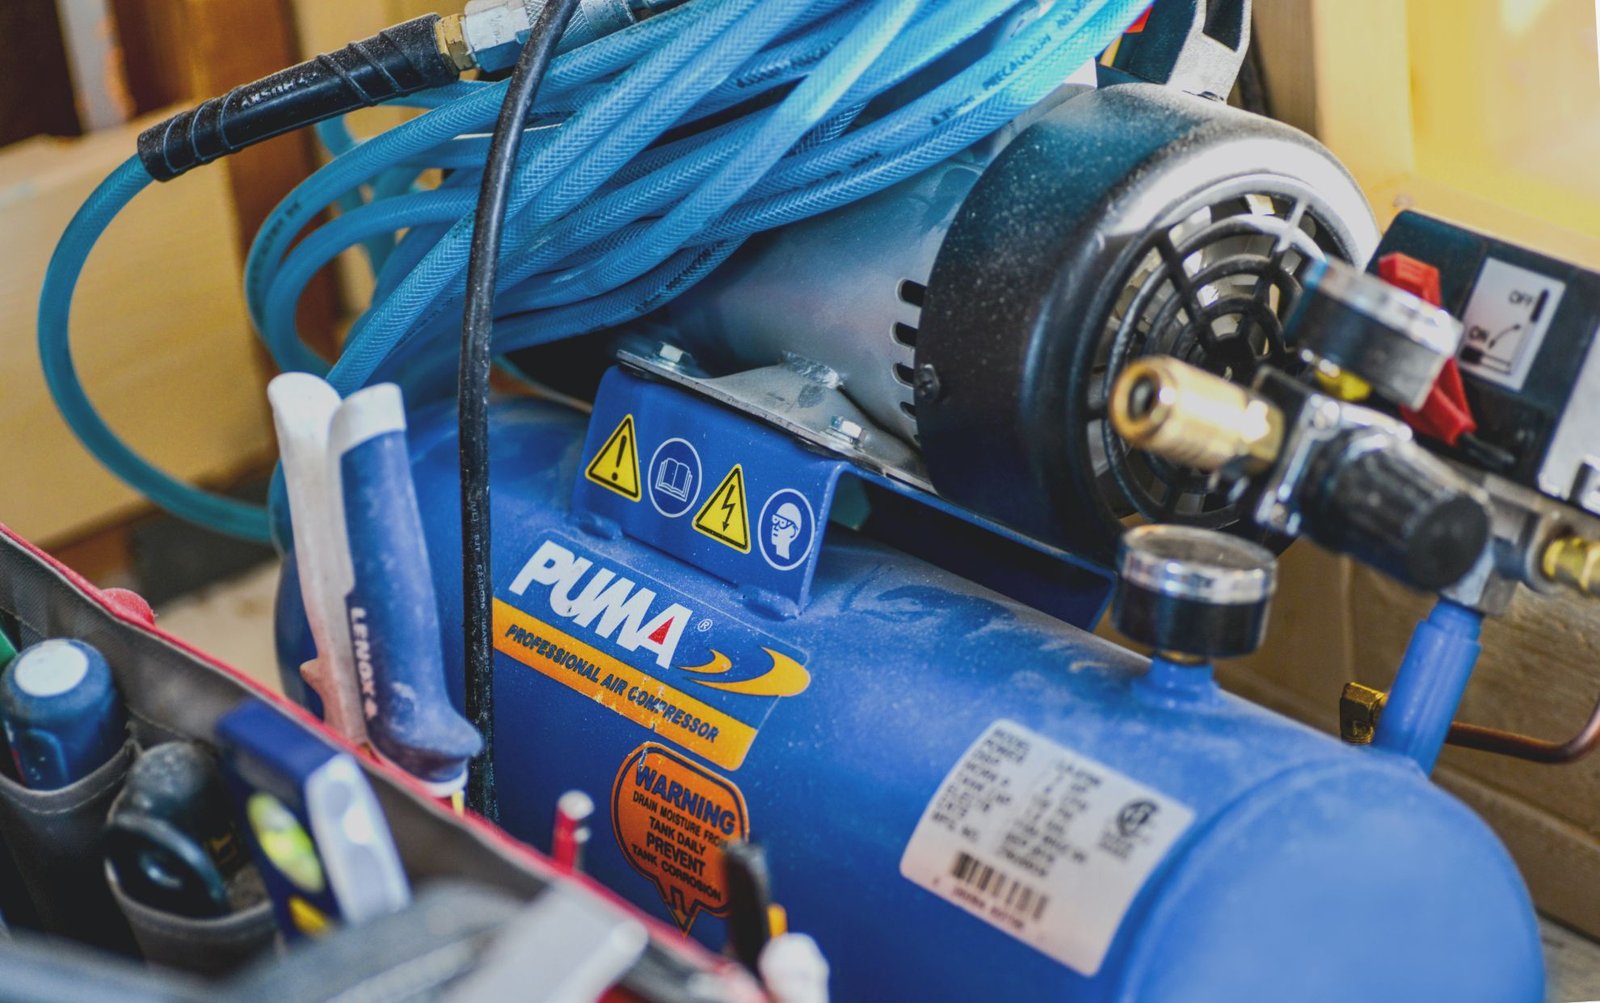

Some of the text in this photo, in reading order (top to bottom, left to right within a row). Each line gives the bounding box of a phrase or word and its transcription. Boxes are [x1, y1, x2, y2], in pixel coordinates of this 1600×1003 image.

[1508, 290, 1534, 306] OFF
[1469, 326, 1488, 342] ON
[508, 539, 693, 670] PUMA
[350, 607, 375, 696] LENOX
[504, 623, 720, 743] PROFESSIONAL AIR COMPRESSOR
[633, 790, 657, 813] DRAIN
[660, 804, 701, 838] MOISTURE
[634, 766, 736, 836] WARNING
[646, 831, 706, 877] PREVENT
[649, 816, 707, 855] TANK DAILY
[631, 843, 722, 902] TANK CORROSION
